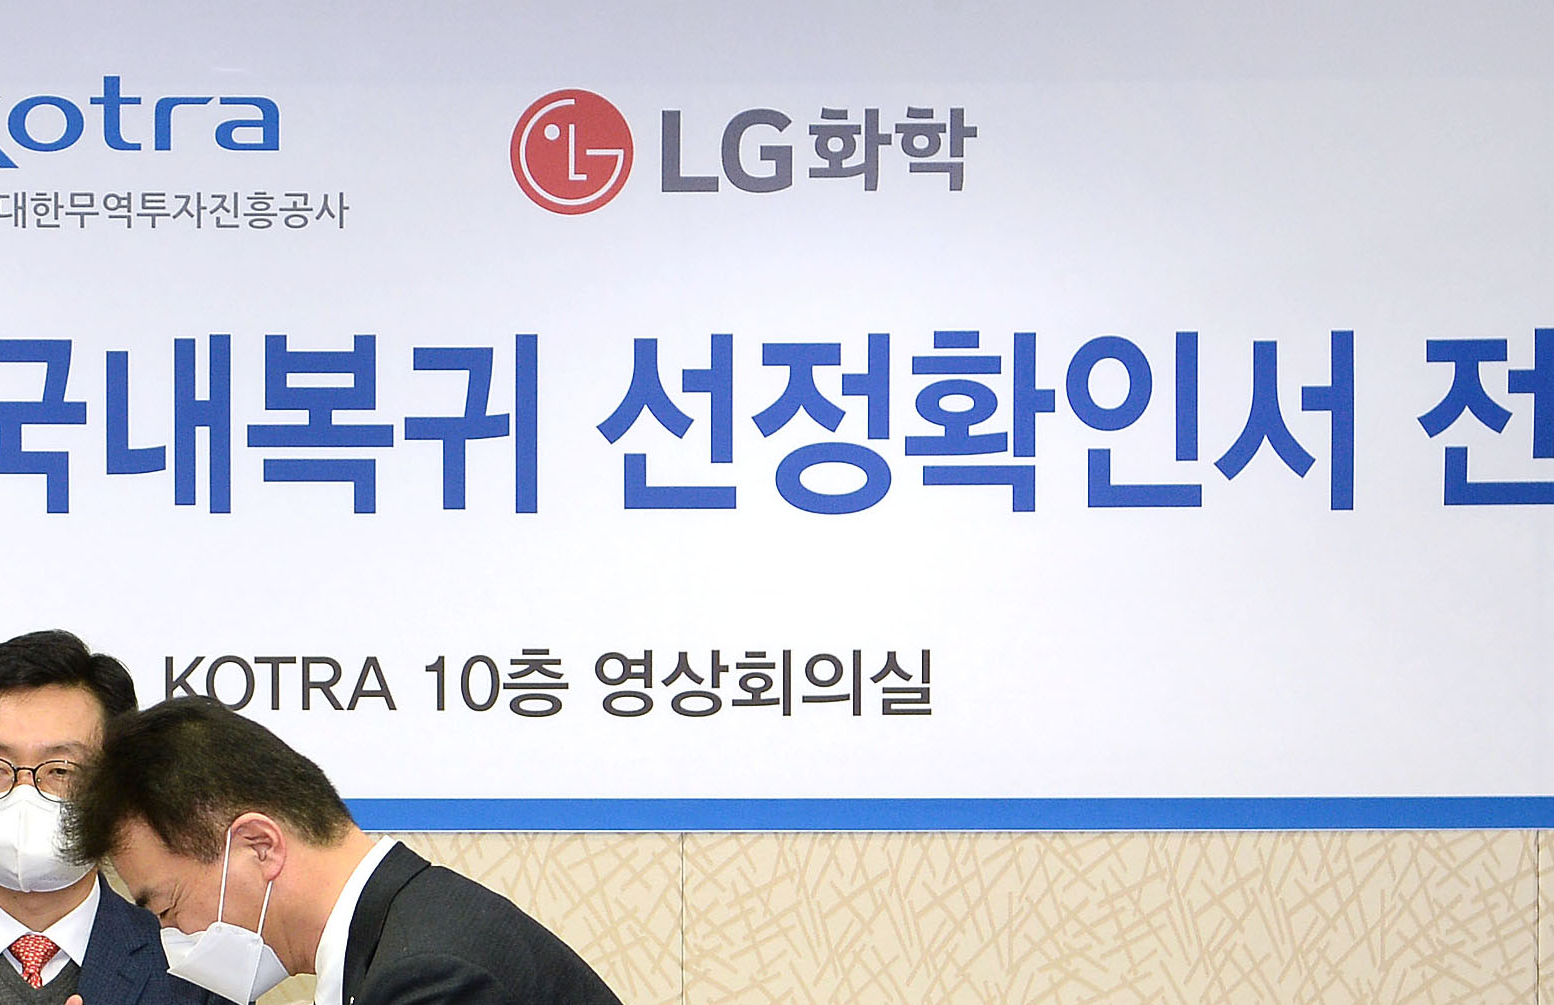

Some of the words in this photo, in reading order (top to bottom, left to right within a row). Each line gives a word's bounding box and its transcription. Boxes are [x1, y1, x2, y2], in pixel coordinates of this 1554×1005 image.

[661, 107, 978, 193] LG화학
[595, 329, 1355, 515] 선정확인서
[164, 655, 398, 712] KOTRA
[425, 649, 569, 718] 10층
[594, 649, 932, 718] 영상회의실
